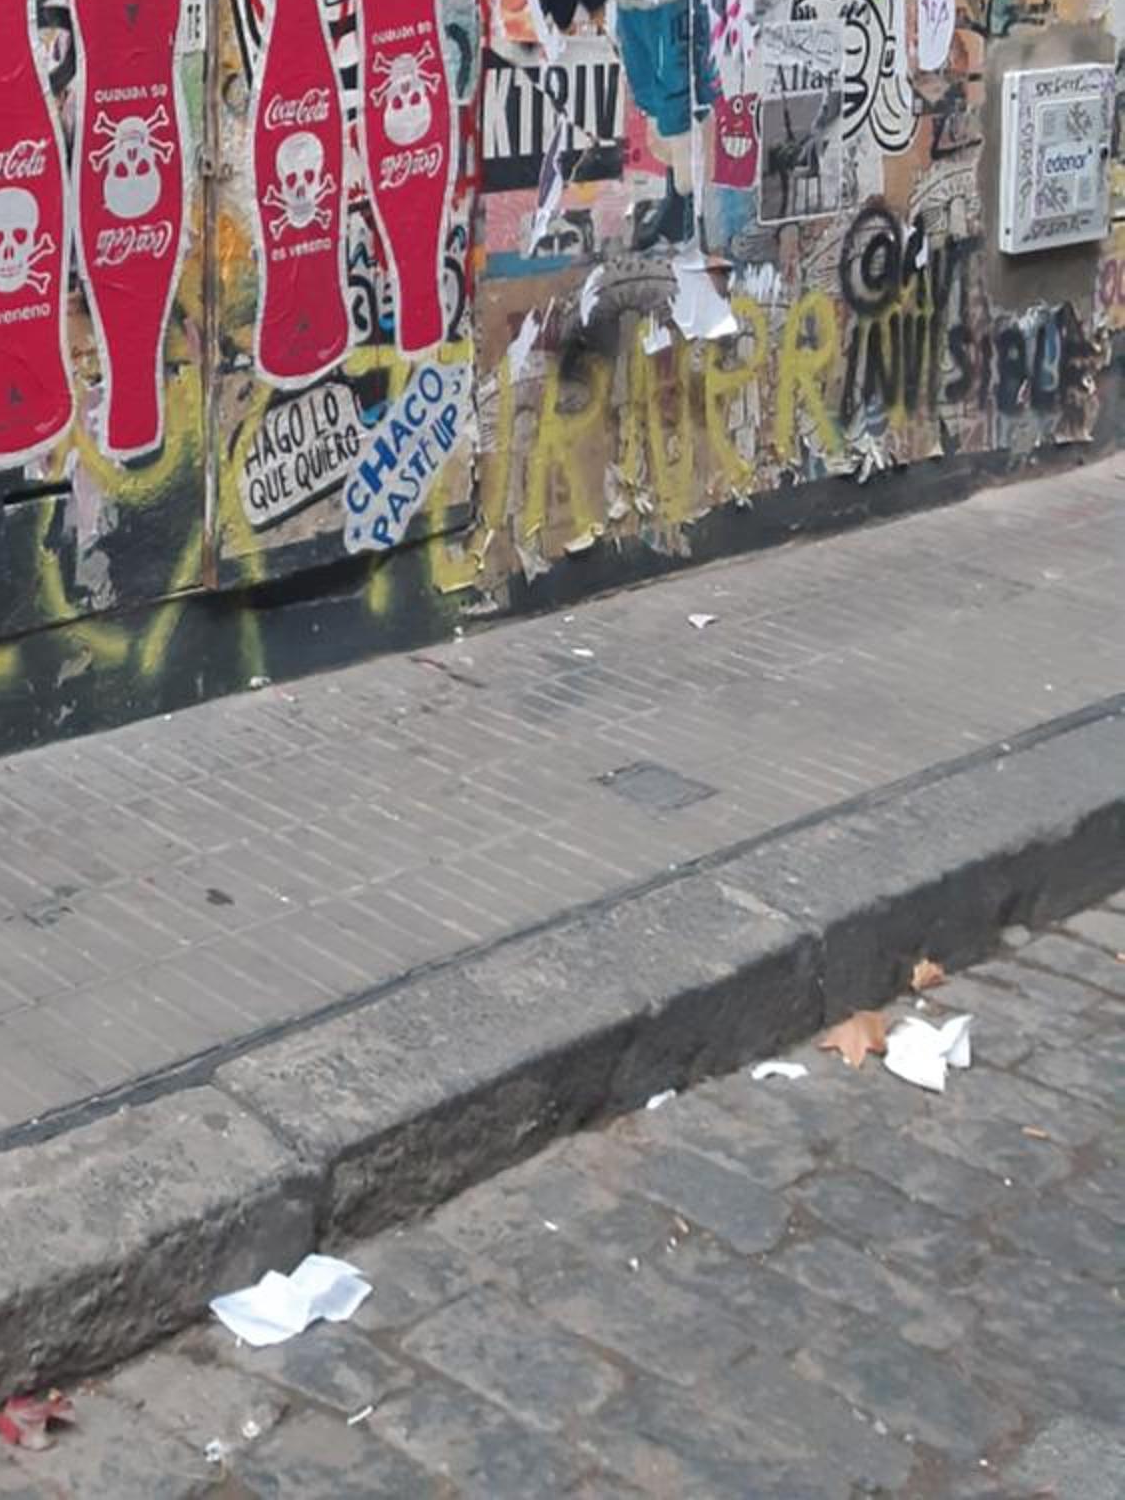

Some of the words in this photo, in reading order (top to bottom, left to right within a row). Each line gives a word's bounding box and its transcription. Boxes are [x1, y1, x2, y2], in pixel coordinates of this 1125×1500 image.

[149, 83, 168, 98] es
[271, 246, 287, 261] es
[289, 237, 332, 258] veneno
[245, 402, 305, 476] HAGO
[308, 390, 340, 441] LO
[249, 467, 293, 512] QUE
[293, 424, 361, 492] QUIERO
[346, 367, 443, 514] CHACO
[372, 438, 440, 547] PASTE
[430, 403, 459, 453] UP
